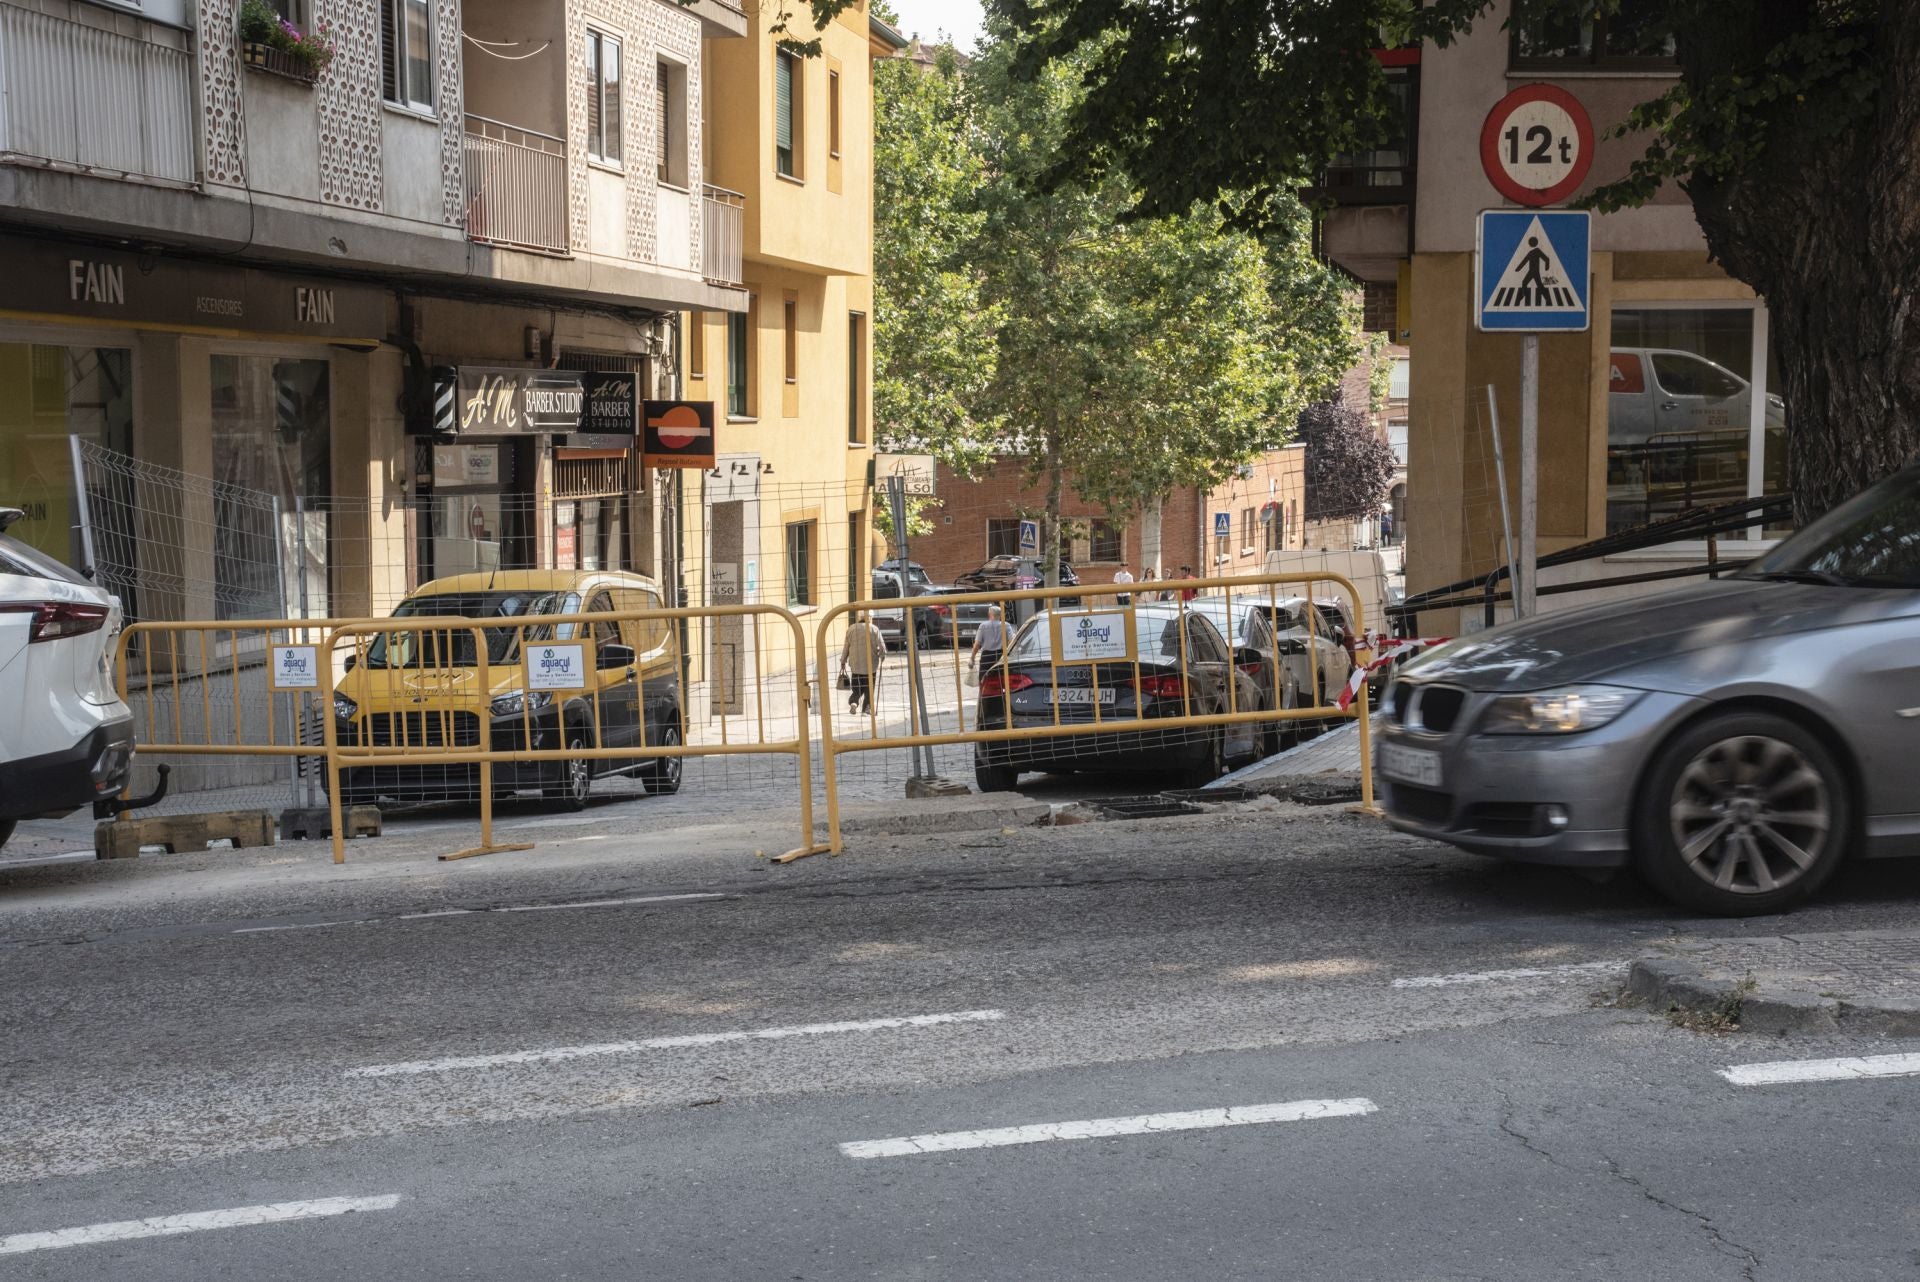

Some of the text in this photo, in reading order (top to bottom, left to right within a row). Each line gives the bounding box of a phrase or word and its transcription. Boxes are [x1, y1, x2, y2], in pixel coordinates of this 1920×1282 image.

[69, 260, 124, 305] FAIN
[196, 296, 243, 317] ASCENSORES
[295, 287, 335, 324] FAIN
[525, 391, 584, 414] BARBER STUDIO
[591, 401, 631, 417] BARBER
[591, 418, 631, 428] STUDIO
[878, 483, 931, 493] ALSO
[22, 503, 48, 521] FAIN
[1076, 625, 1110, 644] aguacyl
[283, 657, 306, 672] aguacyl
[540, 656, 570, 673] aguacyl
[1055, 690, 1083, 702] 324
